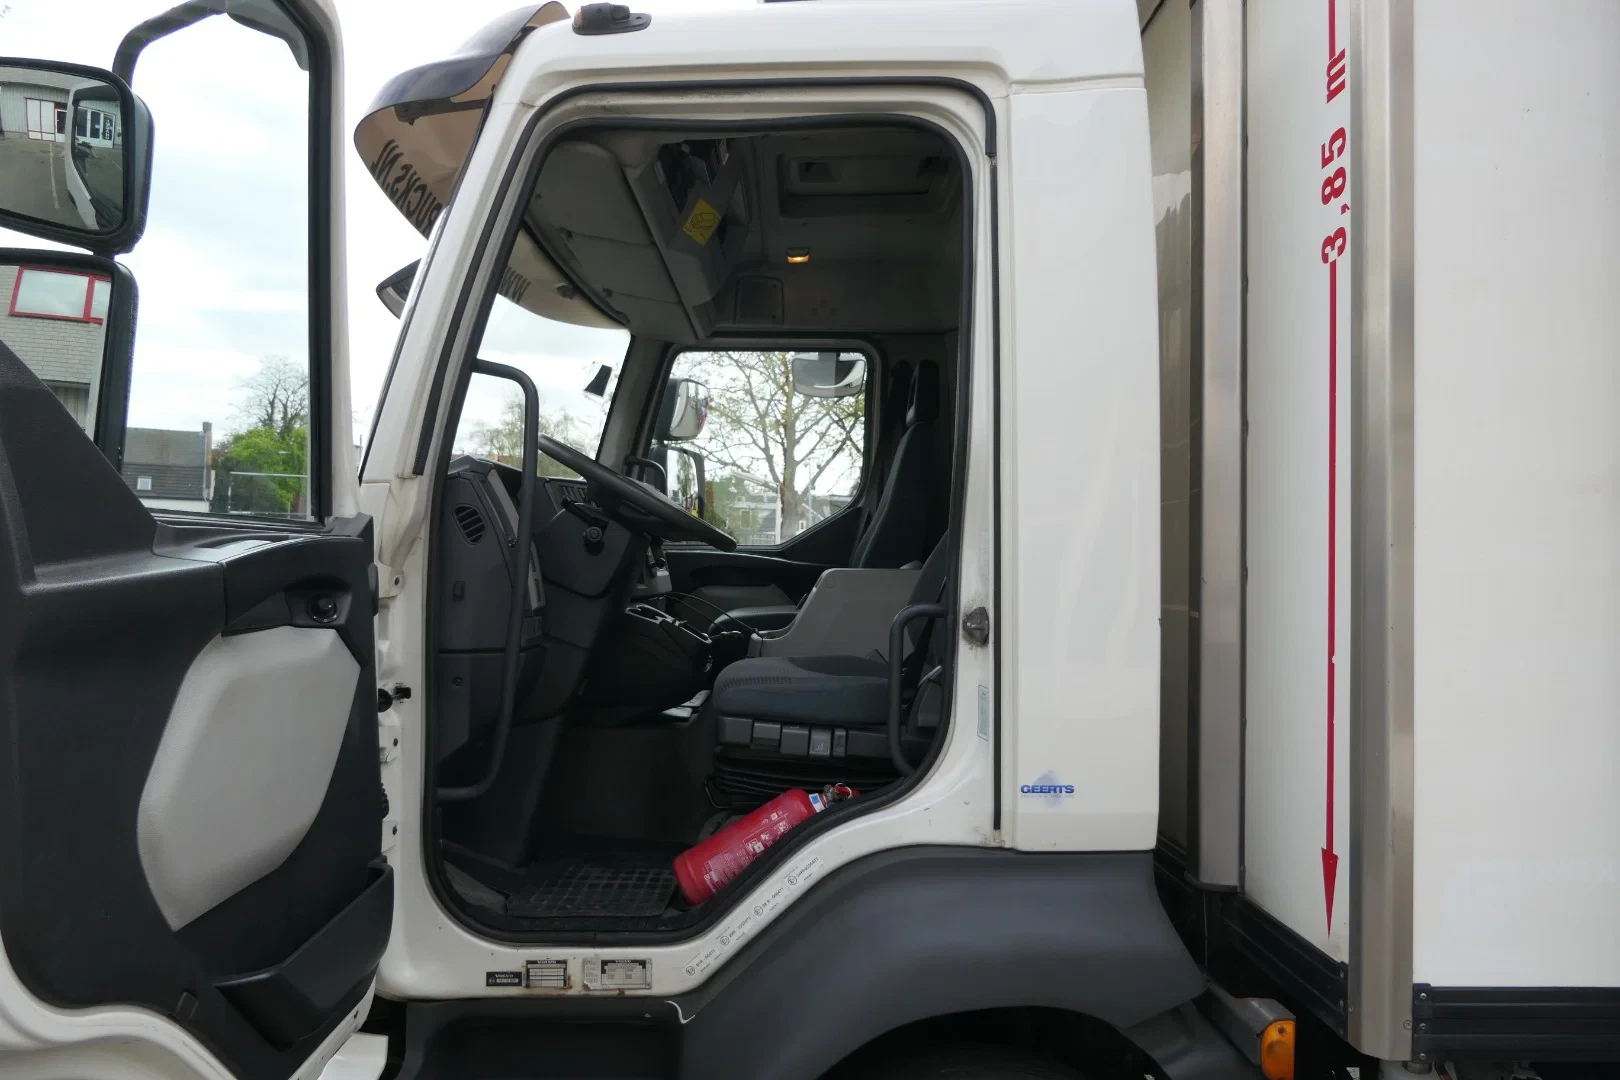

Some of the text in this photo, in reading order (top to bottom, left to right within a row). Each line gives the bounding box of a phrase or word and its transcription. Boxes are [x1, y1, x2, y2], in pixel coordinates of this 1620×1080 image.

[1321, 48, 1350, 265] 3,85 m
[1020, 784, 1075, 794] GEERTS
